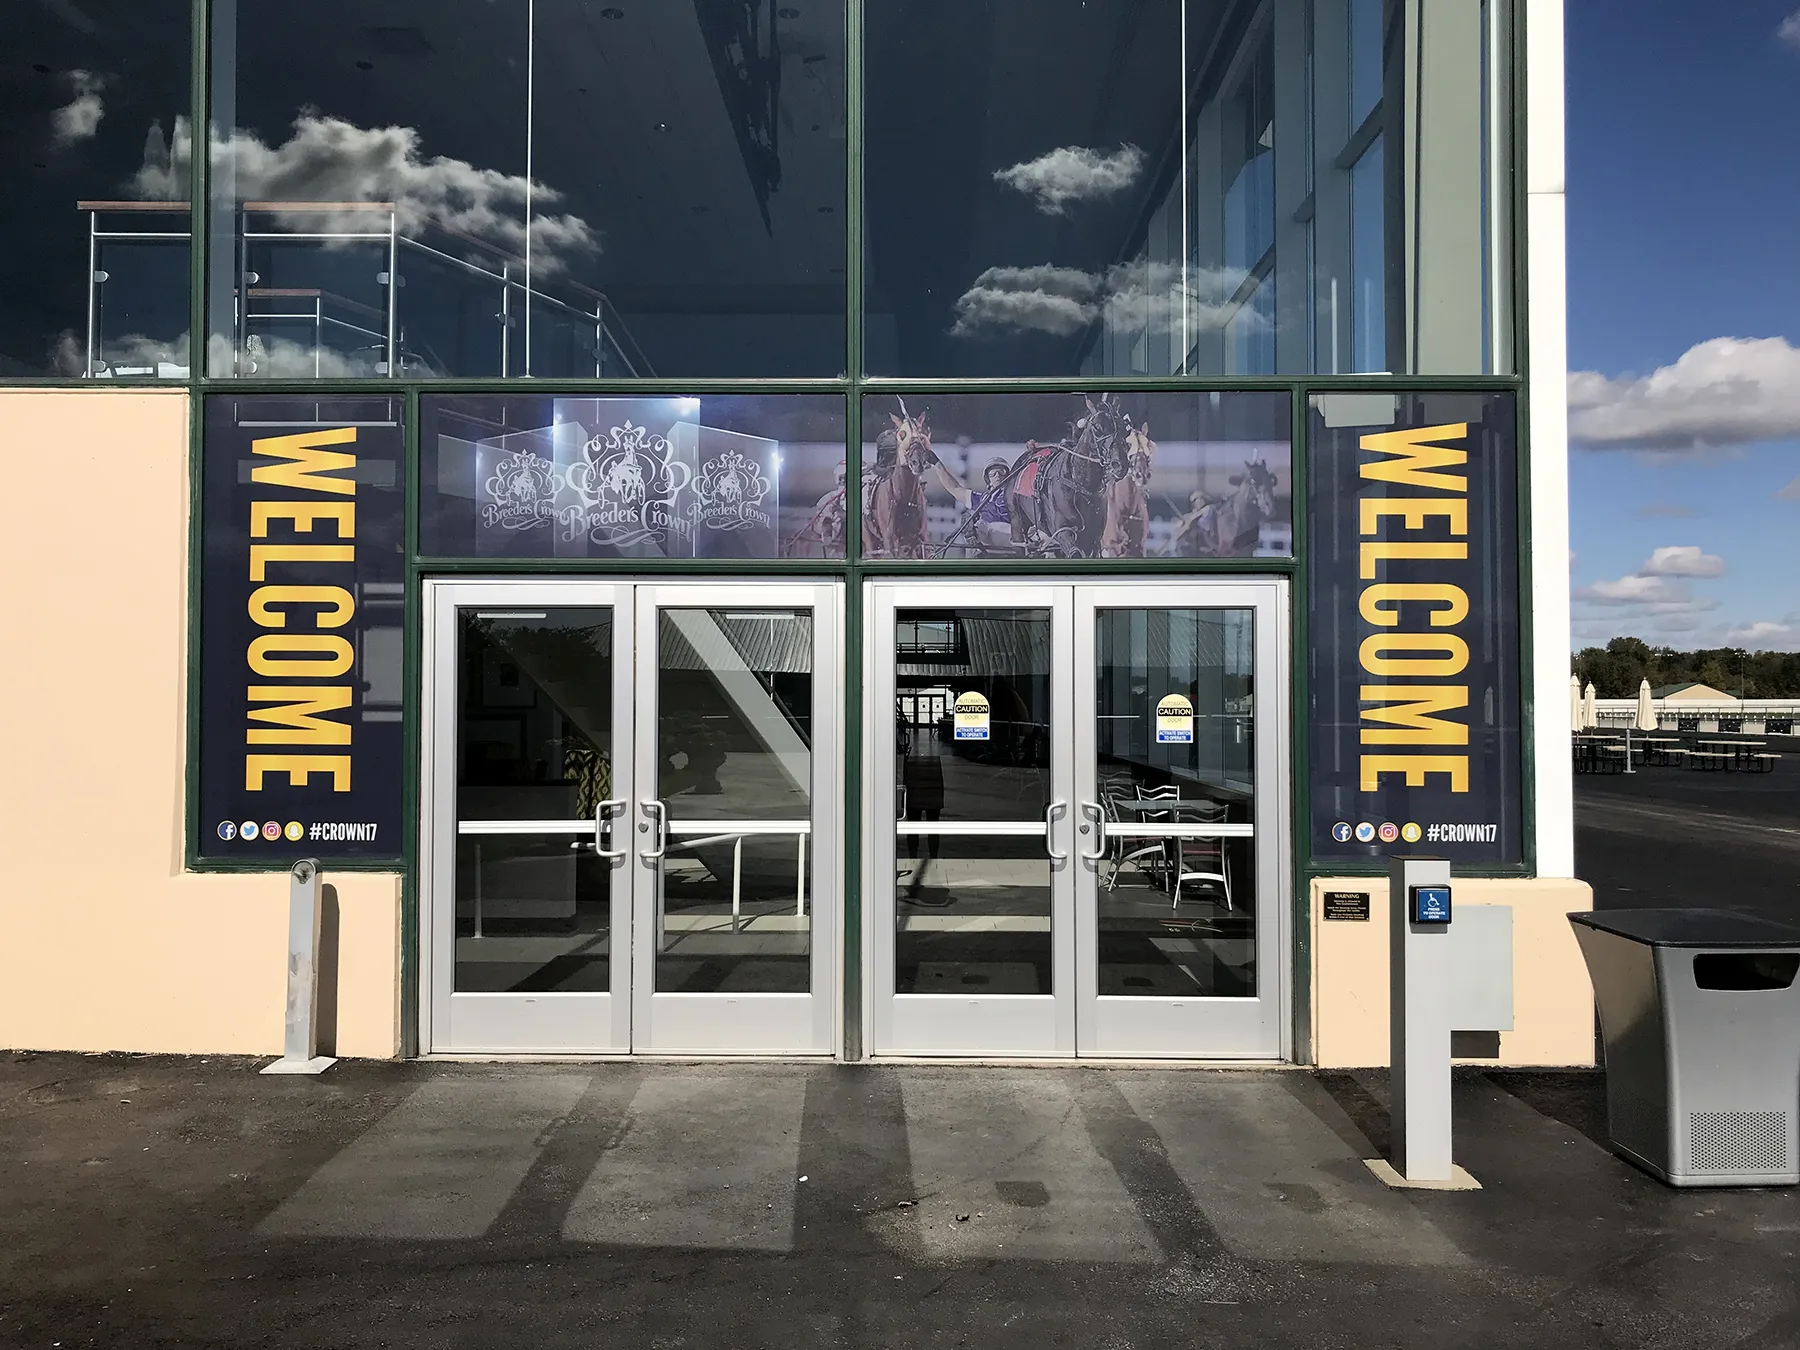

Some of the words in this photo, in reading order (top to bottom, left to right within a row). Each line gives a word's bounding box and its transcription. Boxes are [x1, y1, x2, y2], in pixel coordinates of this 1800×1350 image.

[640, 499, 692, 542] Crown
[738, 500, 771, 529] Crown
[246, 427, 357, 792] WELCOME
[1358, 422, 1470, 793] WELCOME
[309, 822, 377, 842] #CROWN17
[1427, 823, 1497, 842] #CROWN17
